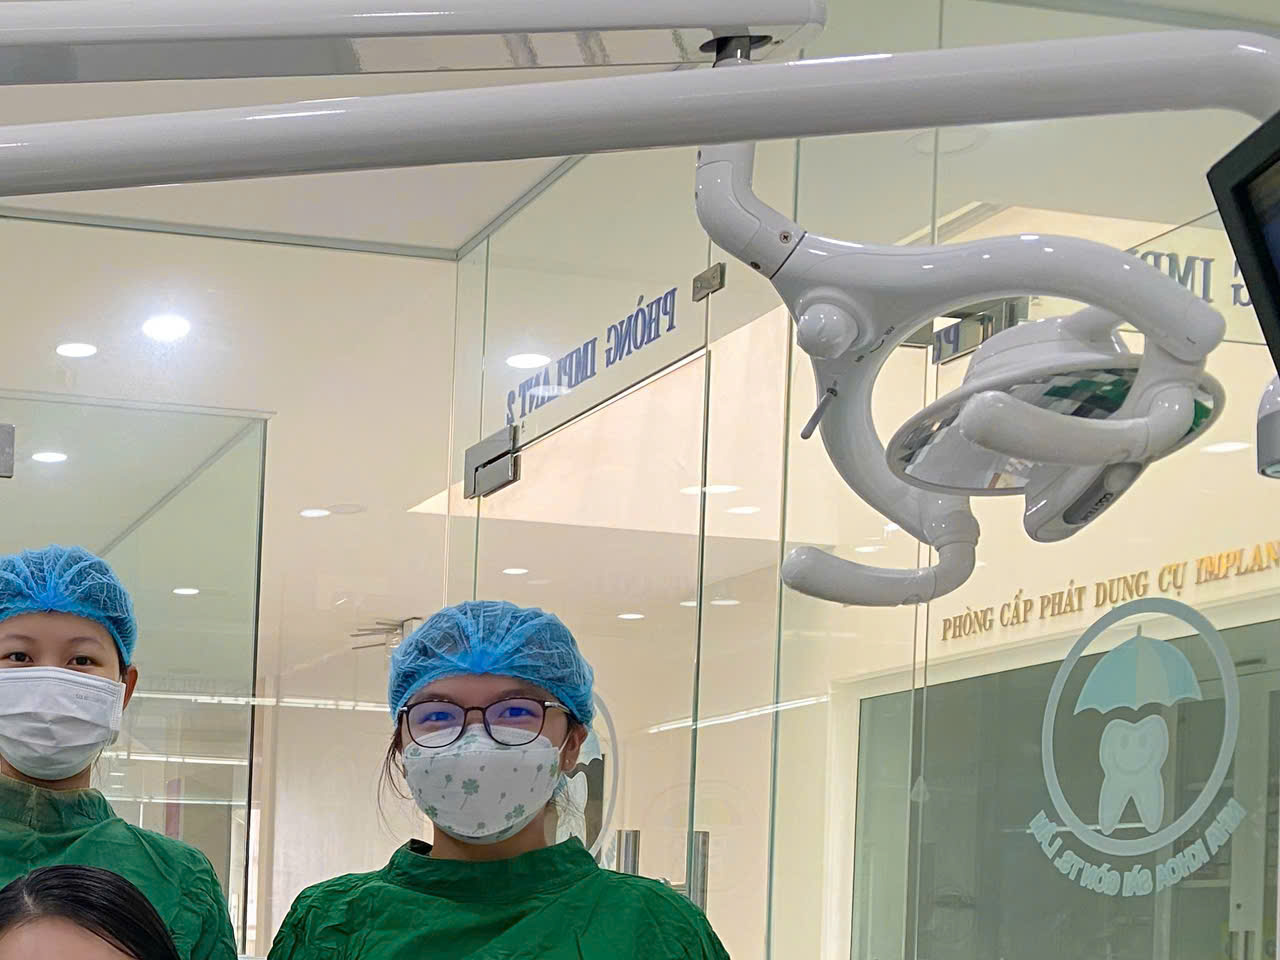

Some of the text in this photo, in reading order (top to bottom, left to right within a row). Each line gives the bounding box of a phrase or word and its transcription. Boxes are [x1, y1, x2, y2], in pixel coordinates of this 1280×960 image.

[941, 605, 995, 642] PHÒNG
[999, 588, 1035, 626] CẤP
[1039, 579, 1087, 619] PHÁT
[1157, 561, 1188, 597] CỤ
